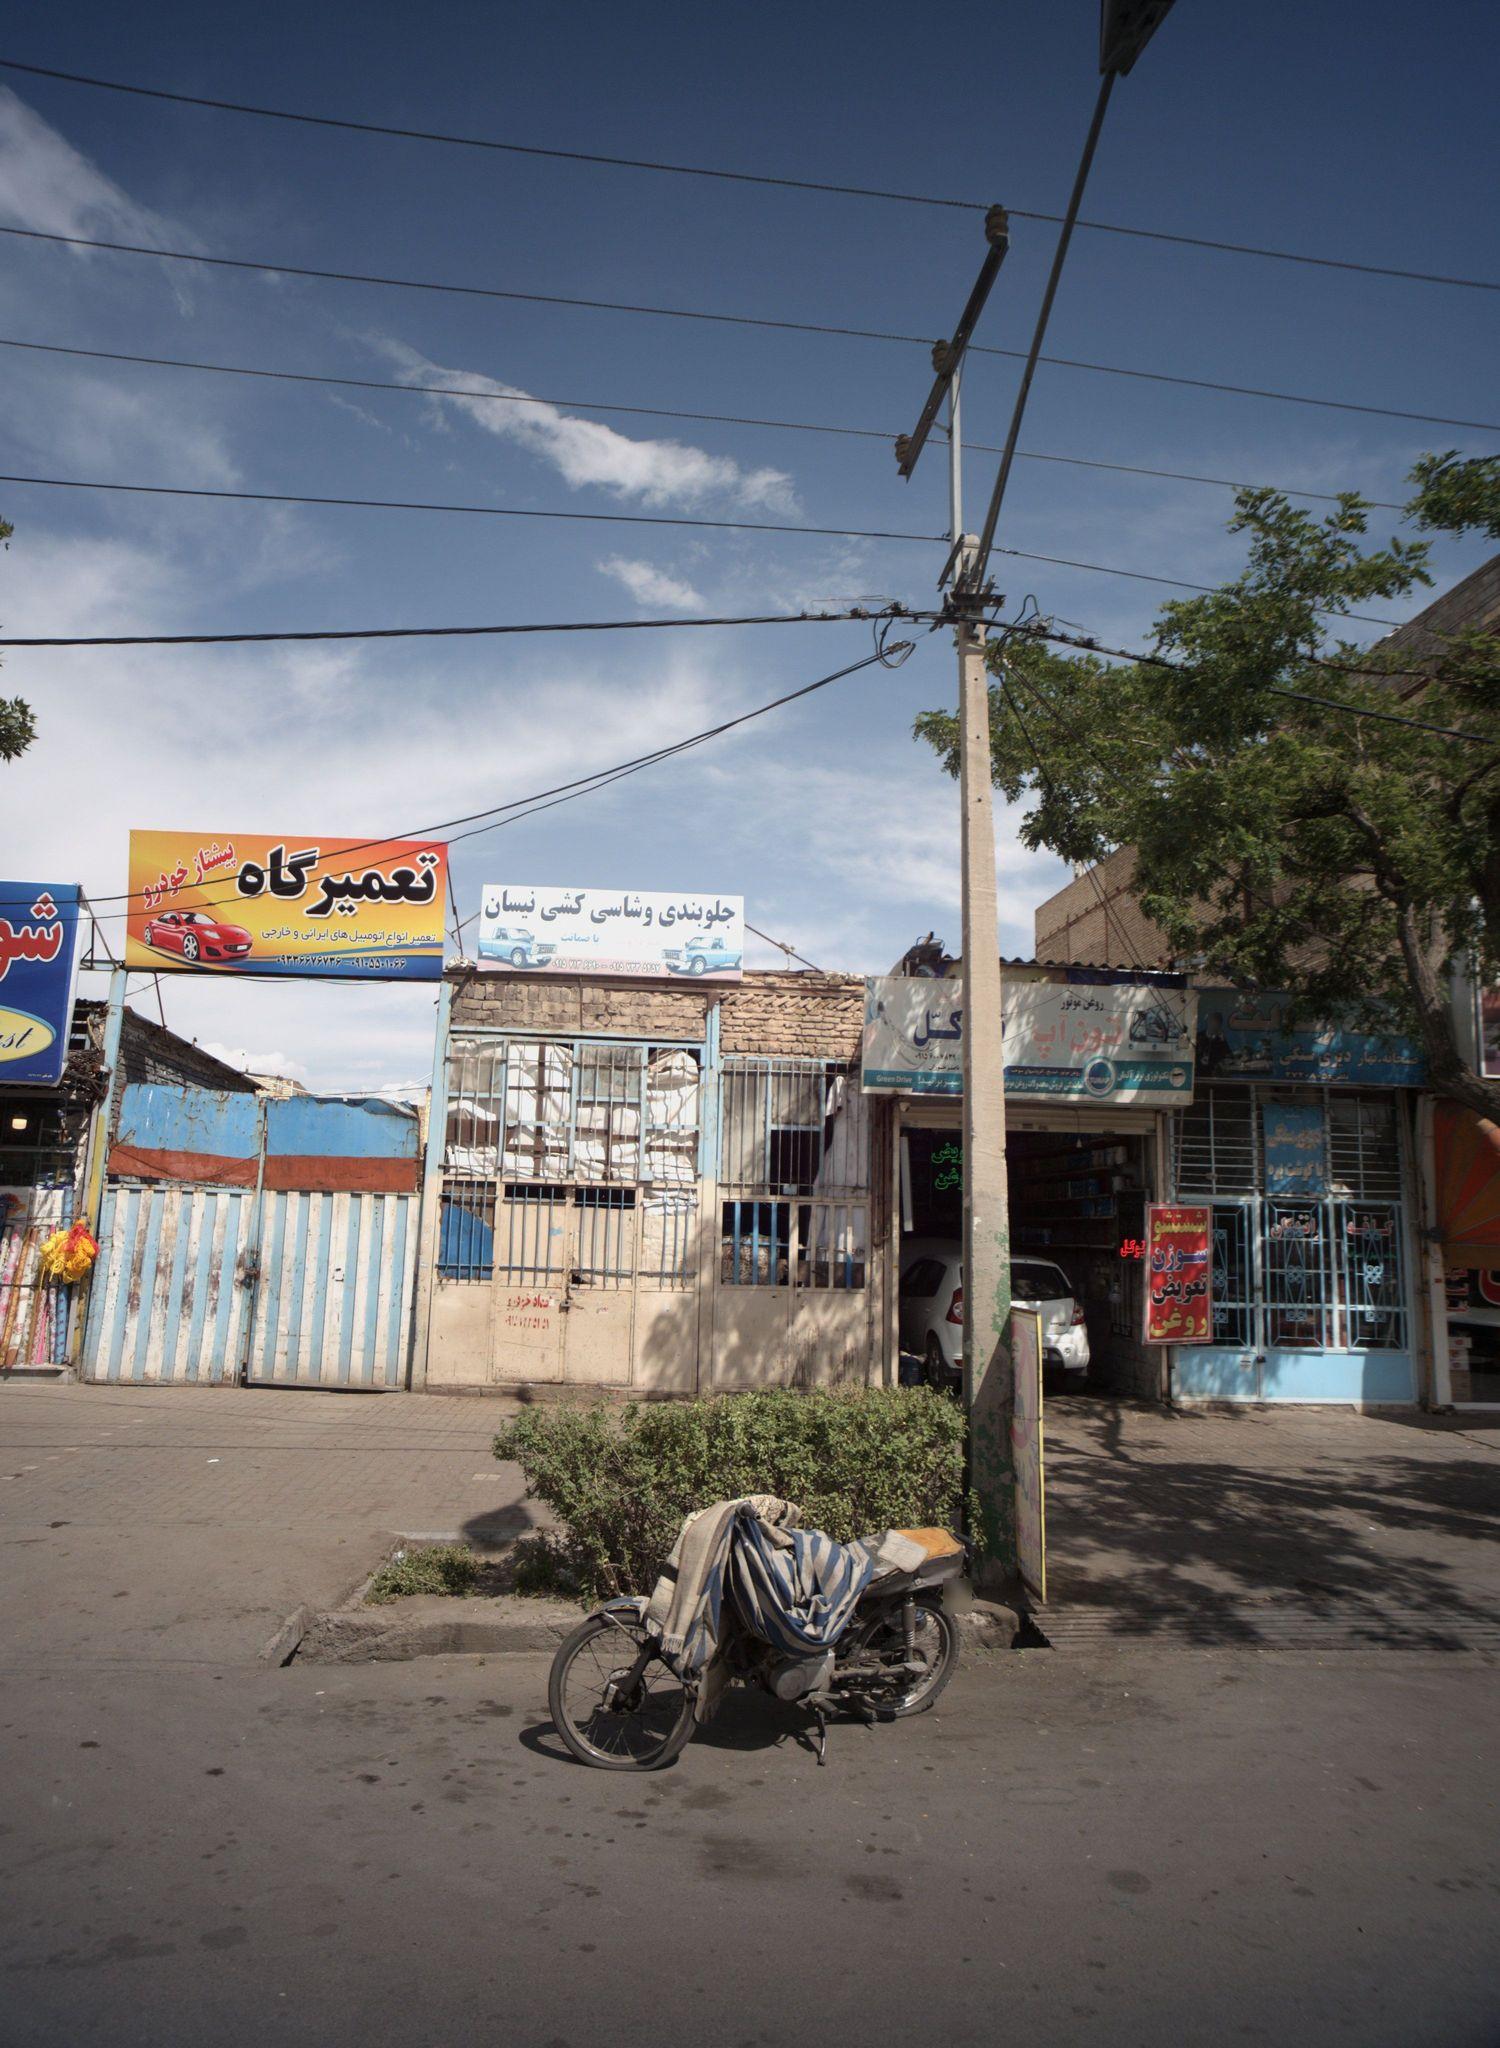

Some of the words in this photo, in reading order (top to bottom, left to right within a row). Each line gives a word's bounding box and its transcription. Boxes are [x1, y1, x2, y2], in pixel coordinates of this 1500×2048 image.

[194, 842, 237, 885] پیشتاز
[143, 859, 189, 909] خودرو
[484, 889, 535, 919] نیسان
[540, 893, 586, 921] کشی
[659, 899, 736, 929] جلوبندی
[262, 927, 291, 940] خارجی
[293, 932, 298, 940] و
[301, 929, 328, 941] ایرانی
[331, 930, 348, 942] های
[350, 931, 385, 942] اتومبیل
[386, 932, 407, 946] انواع
[410, 934, 436, 944] تعمیر
[1152, 1211, 1207, 1242] شستشو
[1152, 1243, 1208, 1272] سوزن
[1152, 1273, 1208, 1305] تعویض
[1150, 1307, 1208, 1337] روغن
